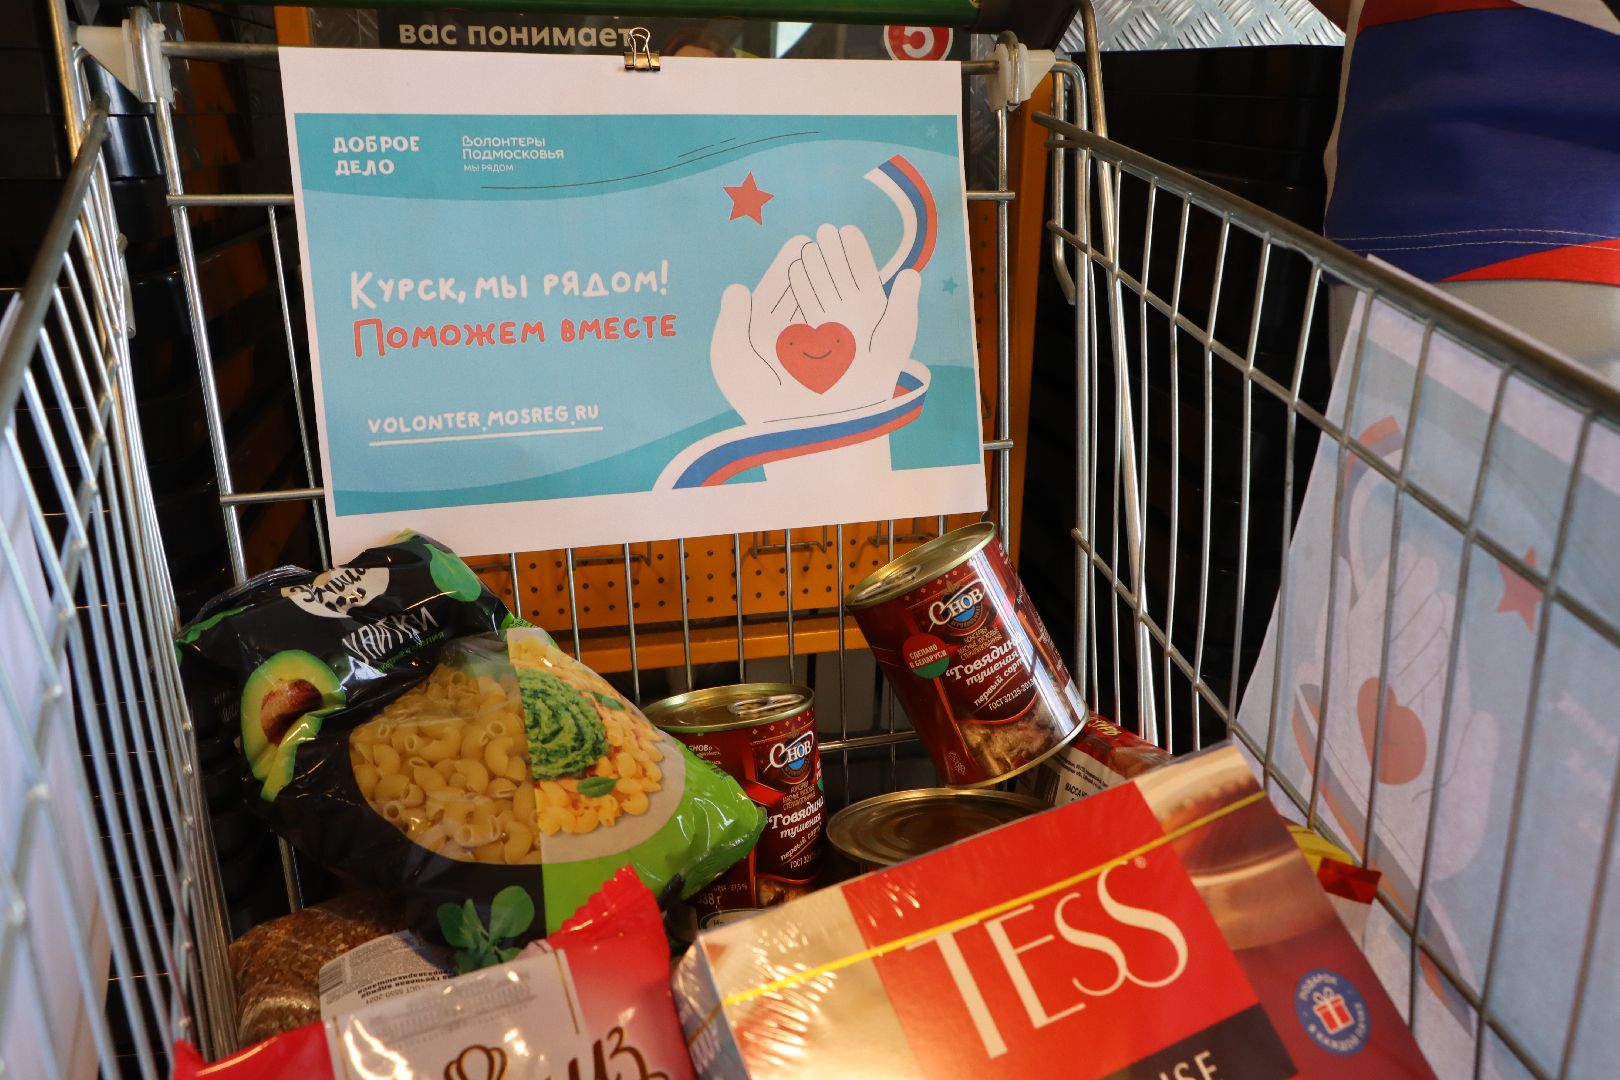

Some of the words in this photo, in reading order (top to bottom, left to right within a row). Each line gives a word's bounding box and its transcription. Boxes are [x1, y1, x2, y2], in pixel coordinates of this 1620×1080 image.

[399, 23, 456, 46] вас
[468, 26, 633, 48] понимает
[333, 136, 420, 153] ДОБРОЕ
[335, 159, 395, 176] ДЕЛО
[481, 164, 514, 172] РЯДОМ
[368, 403, 600, 434] VOLONTER.MOSREG.RU
[909, 644, 938, 660] СДЕЛАНО
[916, 650, 948, 668] БЕЛАРУСИ
[905, 860, 1188, 1059] TESS
